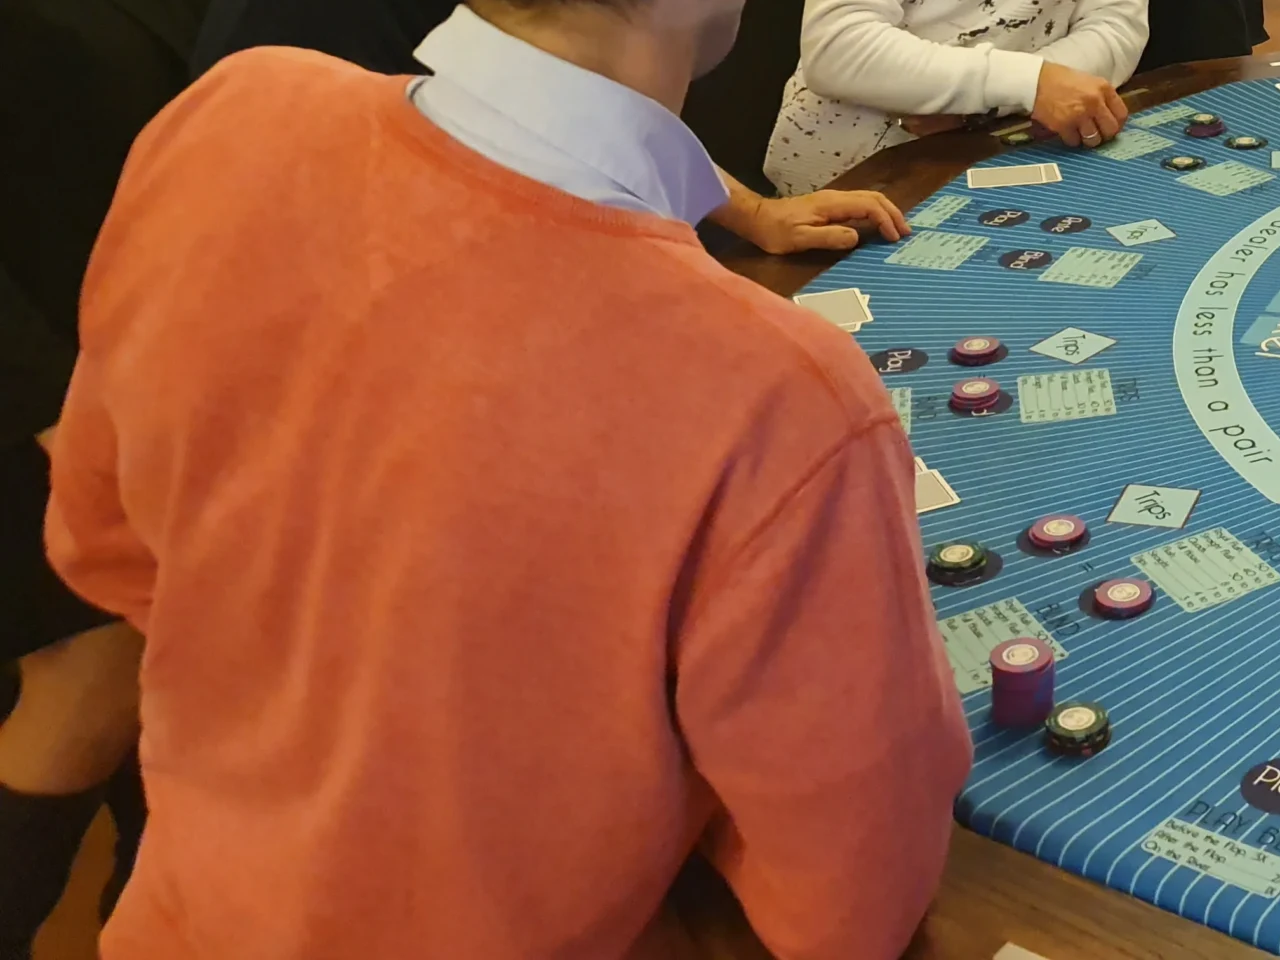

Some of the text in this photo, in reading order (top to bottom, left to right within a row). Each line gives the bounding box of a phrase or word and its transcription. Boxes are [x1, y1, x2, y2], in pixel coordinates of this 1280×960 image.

[1205, 271, 1245, 296] has
[1192, 307, 1228, 336] less
[1193, 348, 1224, 388] than
[1207, 400, 1229, 412] a
[1208, 424, 1273, 464] pair
[1135, 490, 1171, 520] Trips
[1164, 819, 1199, 838] Before
[1185, 800, 1252, 834] PLAY
